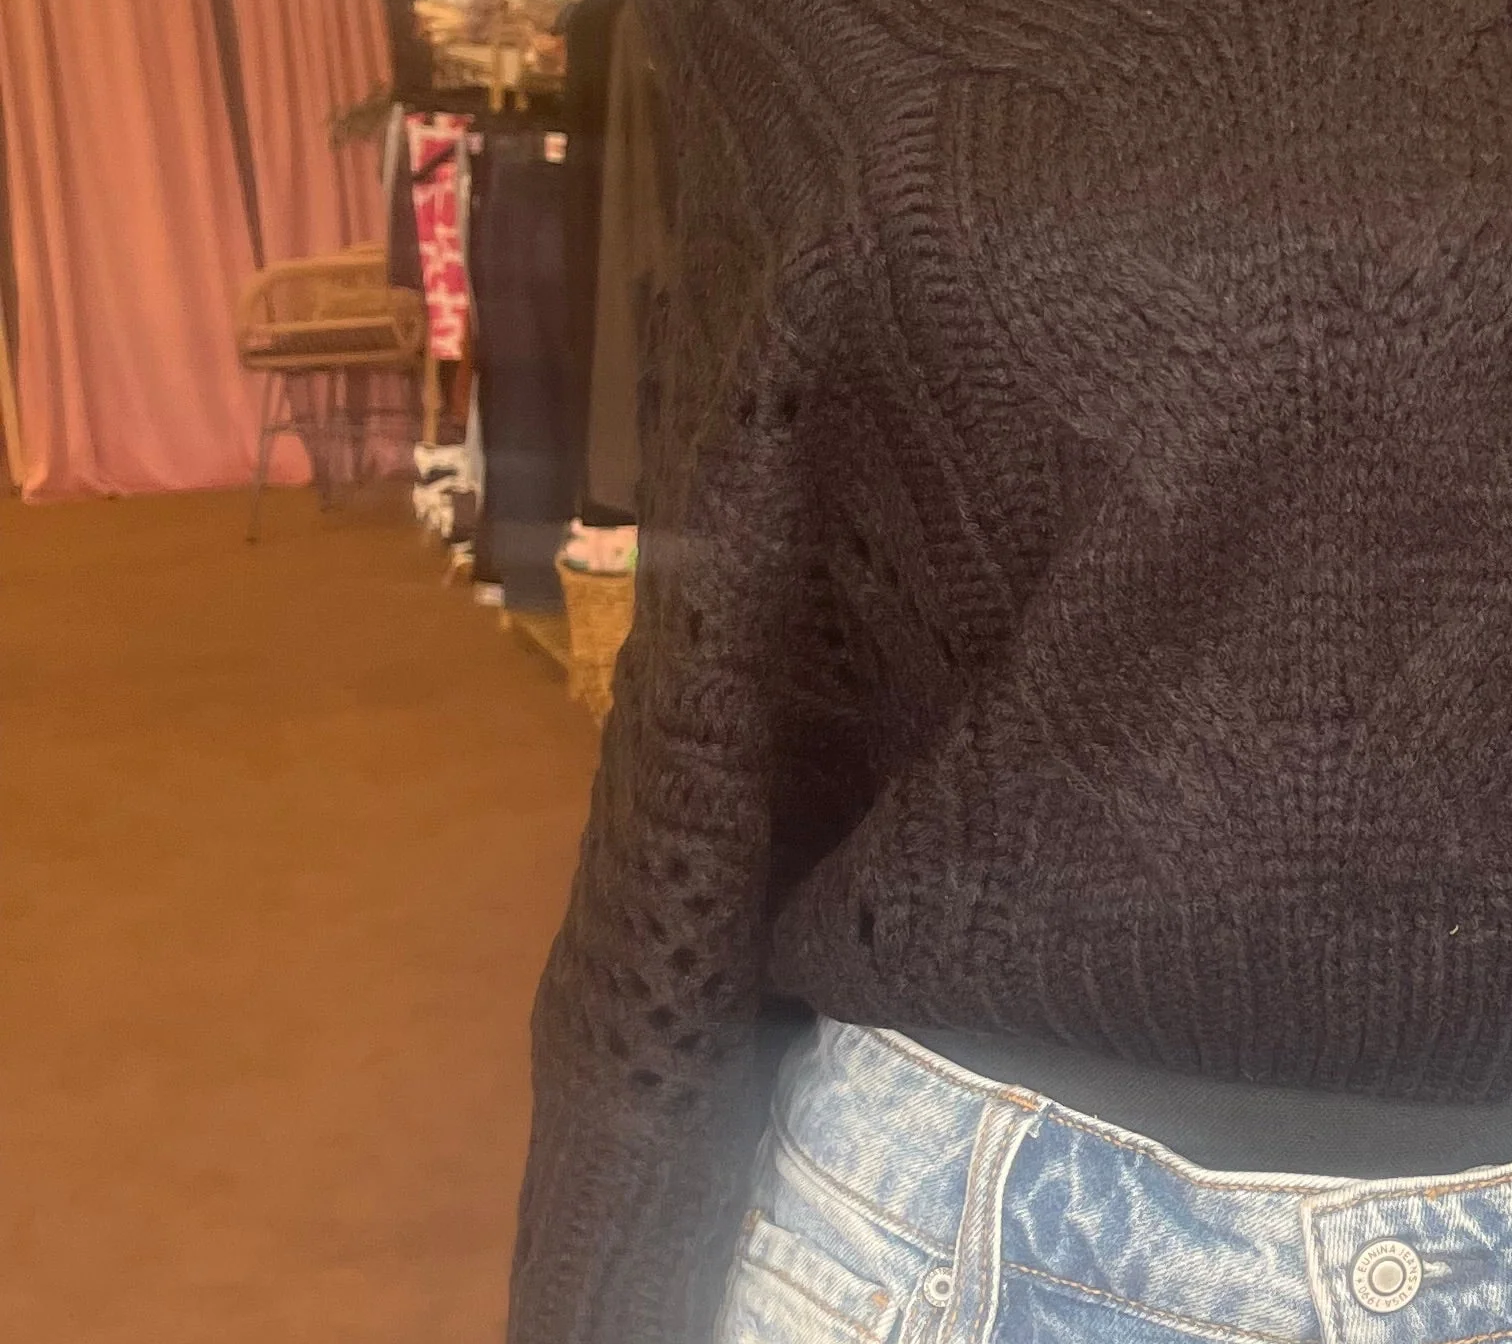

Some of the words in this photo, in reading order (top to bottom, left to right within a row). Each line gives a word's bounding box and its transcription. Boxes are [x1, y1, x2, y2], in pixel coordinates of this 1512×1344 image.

[1358, 1244, 1396, 1273] EUNINA
[1399, 1247, 1418, 1283] JEANS
[1358, 1286, 1381, 1308] 1990
[1384, 1292, 1408, 1308] USA
